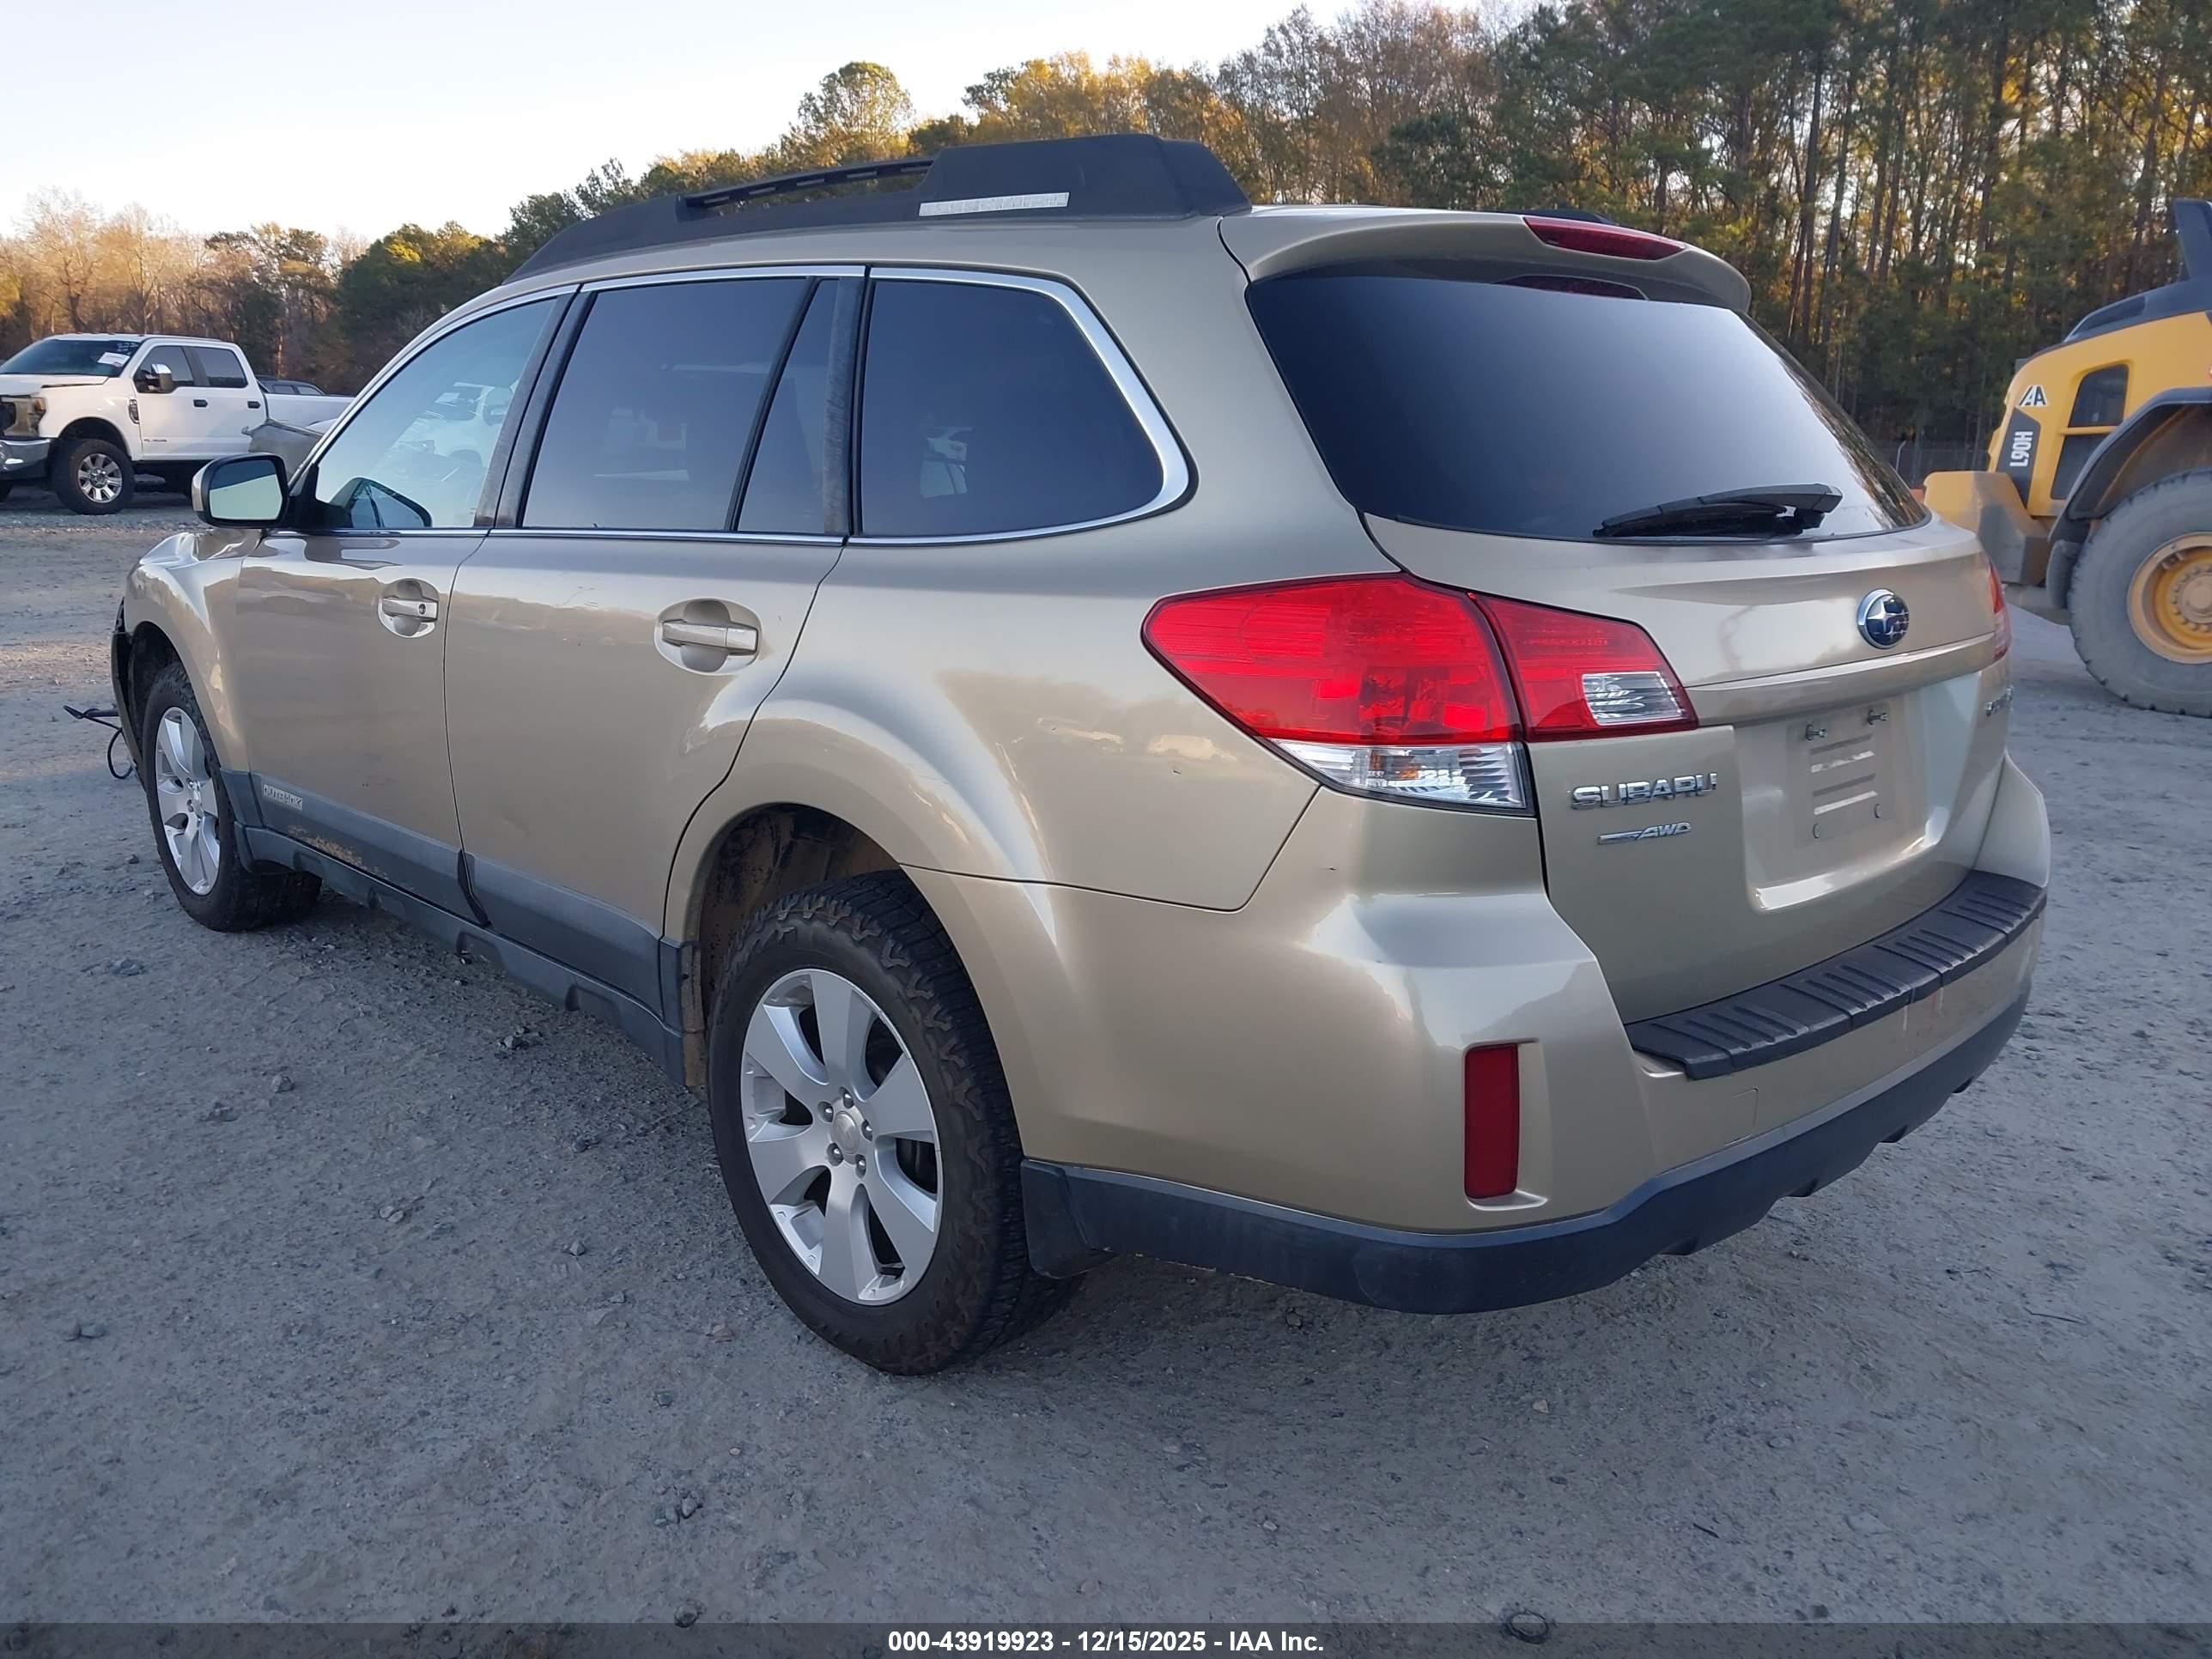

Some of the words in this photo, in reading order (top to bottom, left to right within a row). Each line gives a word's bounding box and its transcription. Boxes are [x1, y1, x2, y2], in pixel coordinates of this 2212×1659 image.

[2009, 431, 2033, 466] L90H
[1572, 773, 1717, 809] SUBARU
[1638, 822, 1692, 840] AWD
